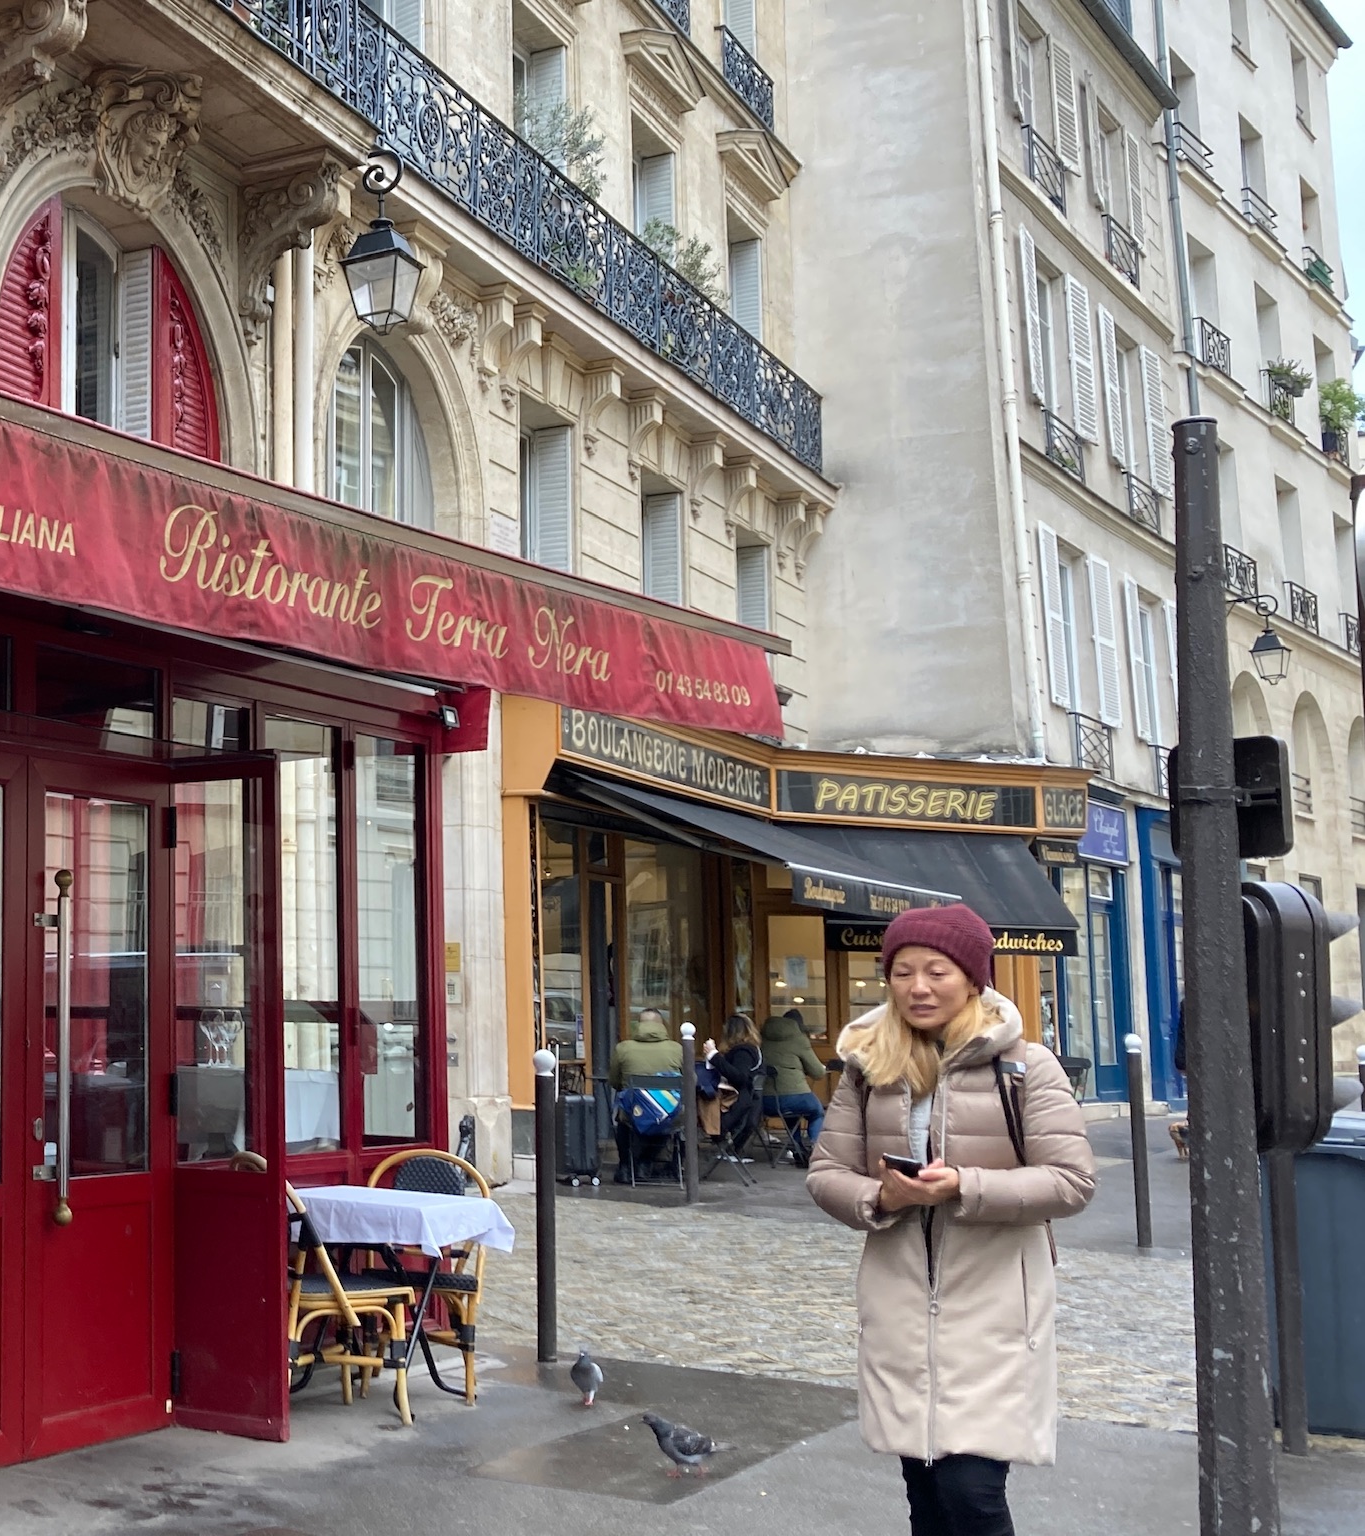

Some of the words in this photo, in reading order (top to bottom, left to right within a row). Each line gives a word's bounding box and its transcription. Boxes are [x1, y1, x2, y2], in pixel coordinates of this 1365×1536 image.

[159, 504, 382, 629] Ristorante
[405, 575, 509, 660] Terra
[527, 606, 612, 682] Nera
[656, 671, 673, 694] 01
[676, 674, 693, 698] 43
[694, 678, 712, 700] 54
[713, 681, 730, 703] 83
[731, 684, 751, 707] 09
[572, 708, 687, 780] BOULANGERIE
[691, 749, 762, 801] MODERNE
[814, 778, 998, 821] PATISSERIE
